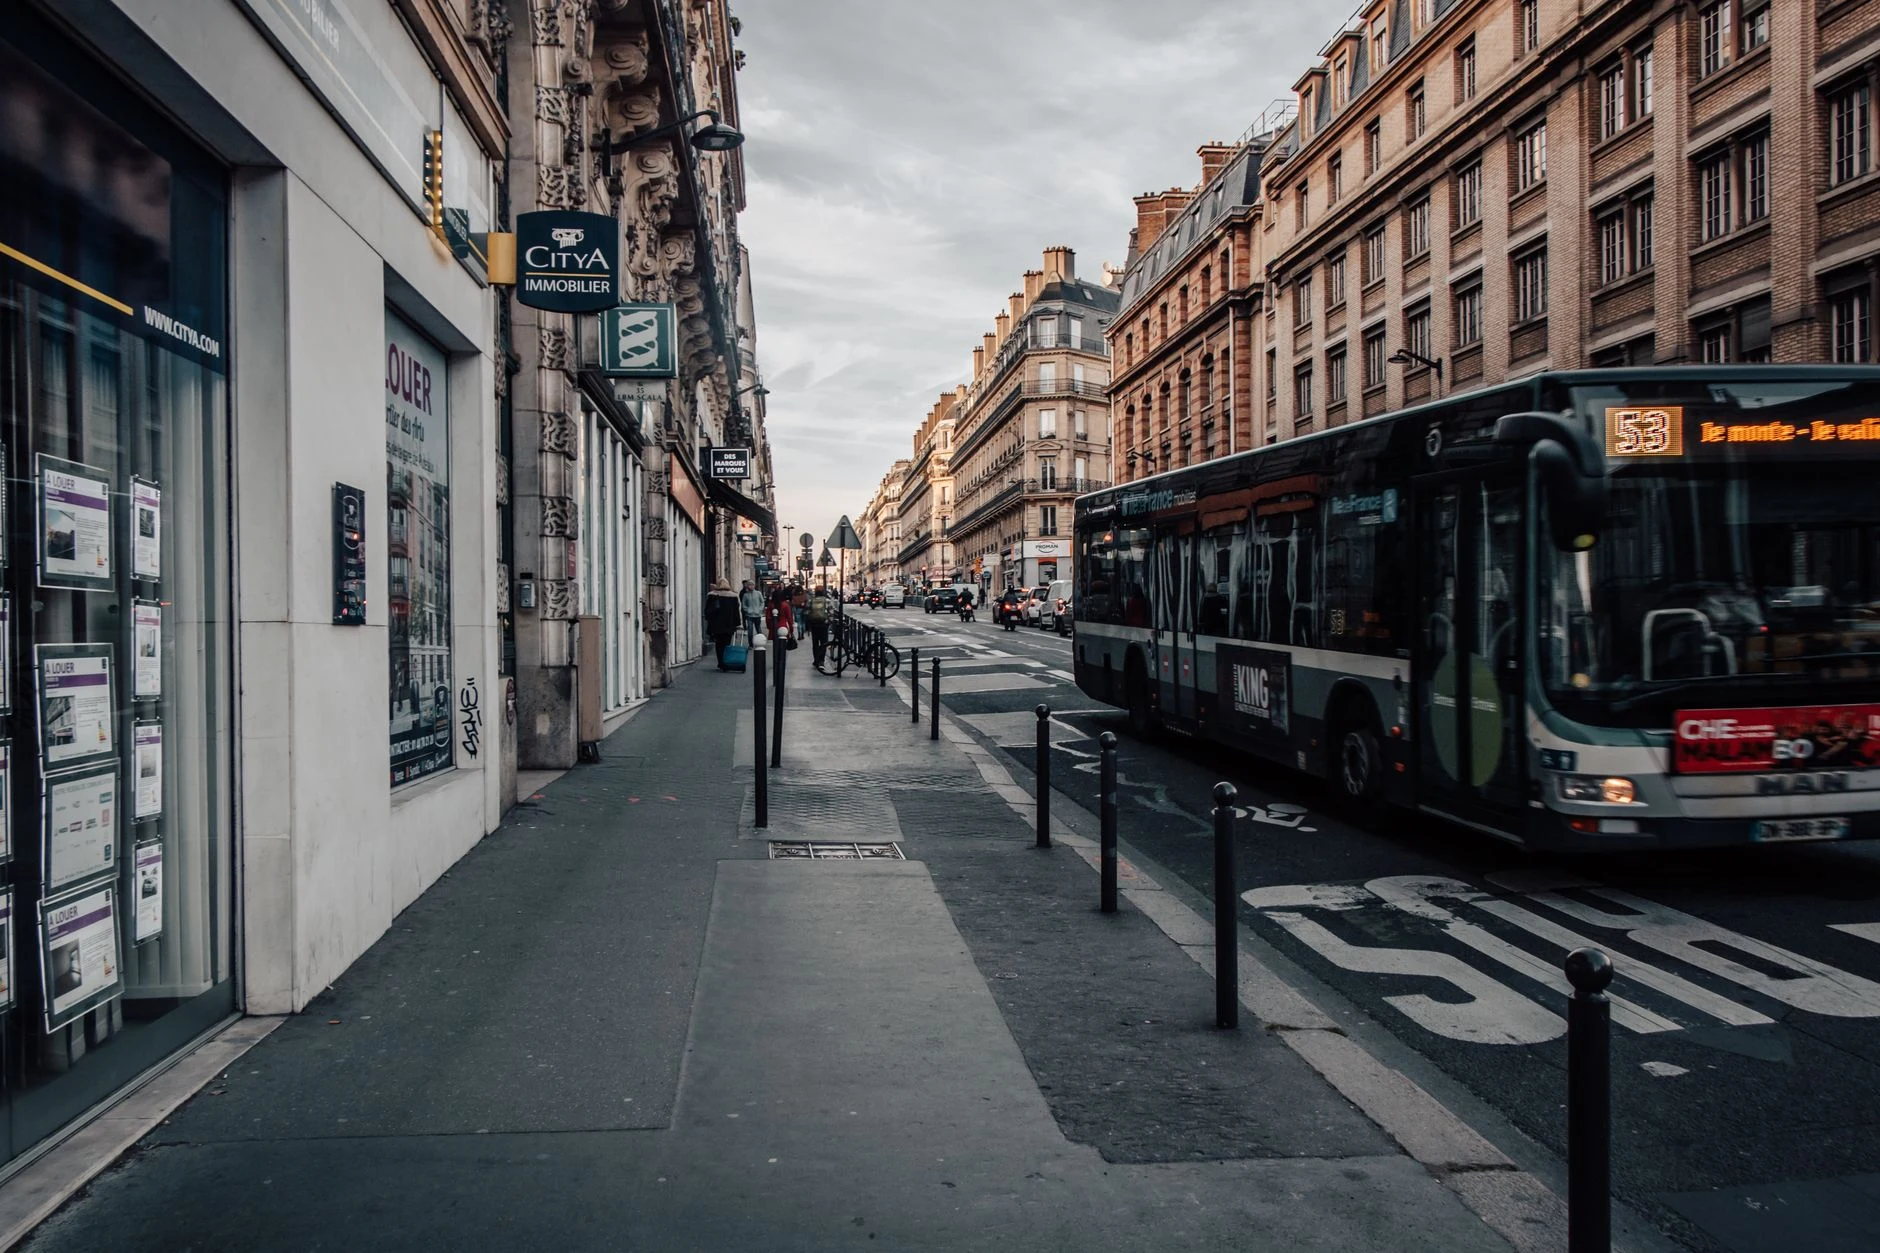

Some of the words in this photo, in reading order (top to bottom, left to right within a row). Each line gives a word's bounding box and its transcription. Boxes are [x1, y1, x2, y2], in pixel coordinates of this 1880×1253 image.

[525, 279, 610, 293] IMMOBILIER
[144, 305, 220, 358] WWW.CITYA.COM
[1615, 411, 1670, 454] 53
[1237, 664, 1269, 708] KING
[1679, 718, 1739, 740] CHE
[1755, 771, 1849, 794] MAN
